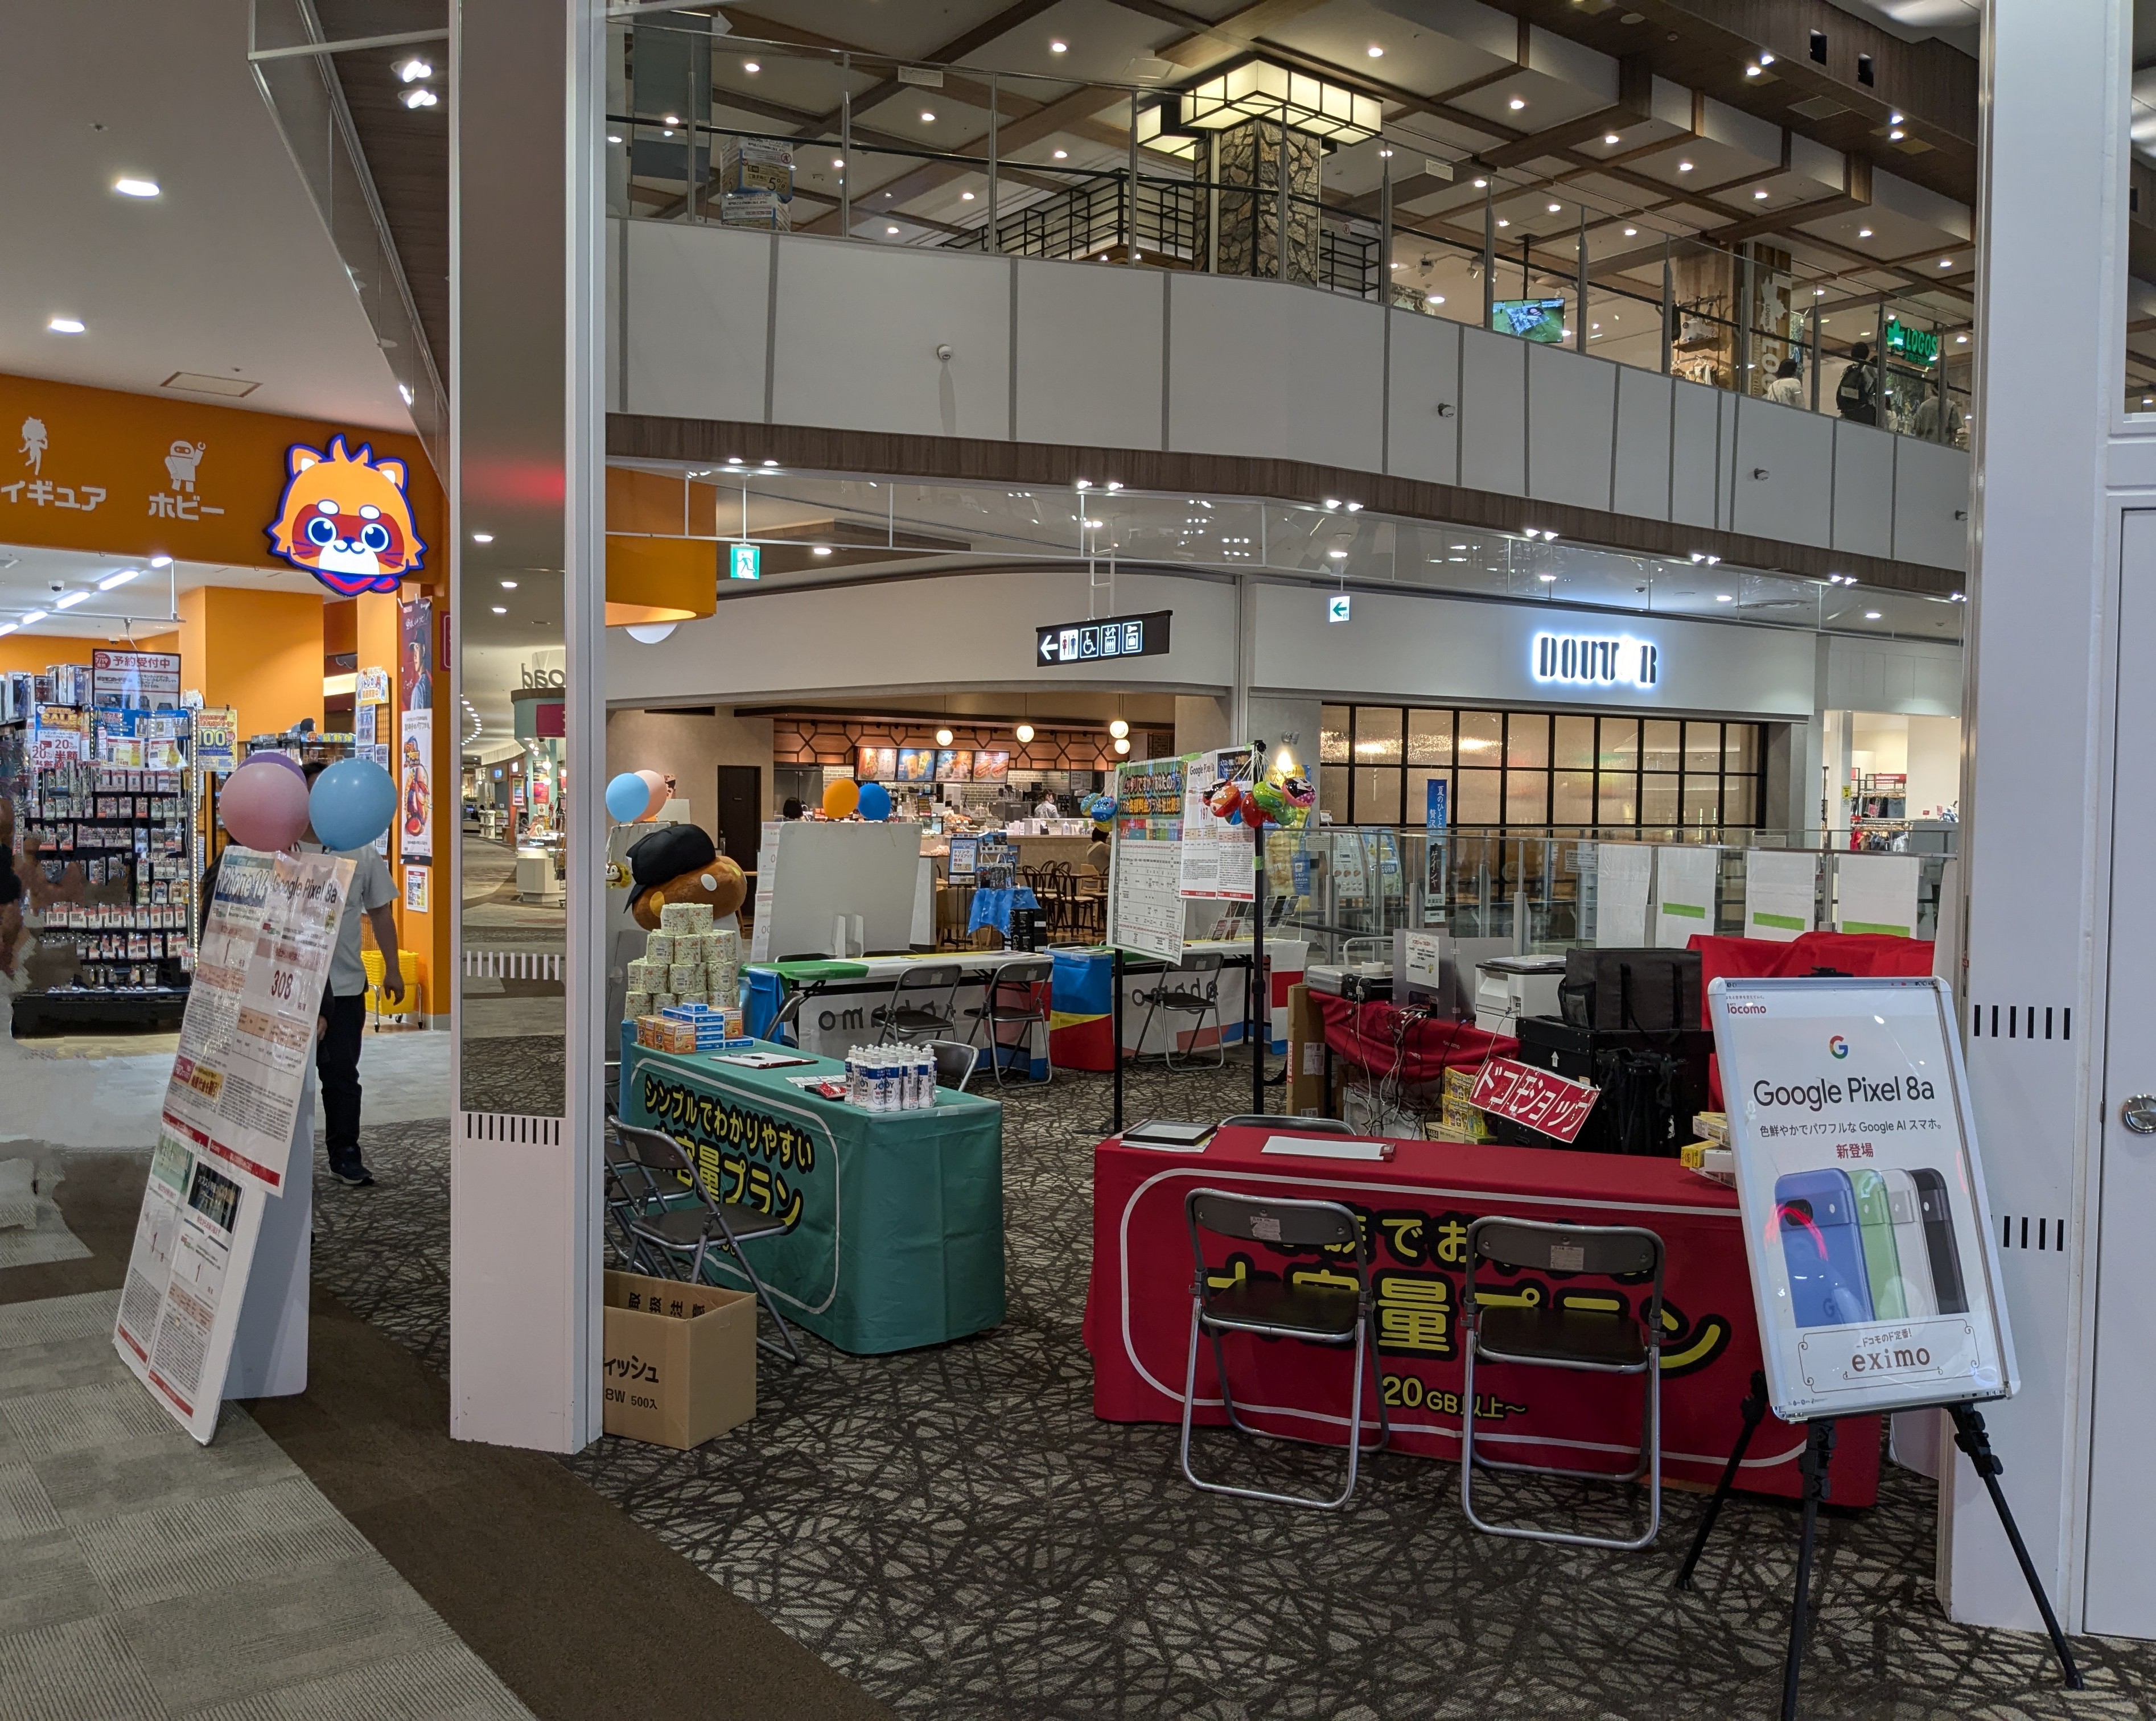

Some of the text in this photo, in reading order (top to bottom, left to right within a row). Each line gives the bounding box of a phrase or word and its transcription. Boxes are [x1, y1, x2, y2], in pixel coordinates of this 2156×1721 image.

[1906, 328, 1937, 356] LOGOS
[149, 494, 225, 520] ホビー
[113, 656, 170, 668] 予約受付中
[1539, 636, 1657, 684] DOUTR
[40, 712, 77, 724] SALE
[55, 739, 69, 750] 20
[55, 750, 78, 760] 半額
[303, 878, 326, 901] Pixel
[325, 882, 338, 904] 8a
[271, 969, 293, 1000] 308
[1473, 1061, 1594, 1134] ドコモショップ
[1753, 1076, 1935, 1111] Google Pixel 8a
[647, 1080, 812, 1167] シンプルでわかりやすい
[1760, 1118, 1941, 1138] 色鮮やかでパワフルな Google AI スマホ。
[1836, 1142, 1874, 1159] 新登場
[1862, 1328, 1913, 1347] ドコモのド定番!
[1851, 1347, 1931, 1372] eximo
[631, 1395, 659, 1410] 500入
